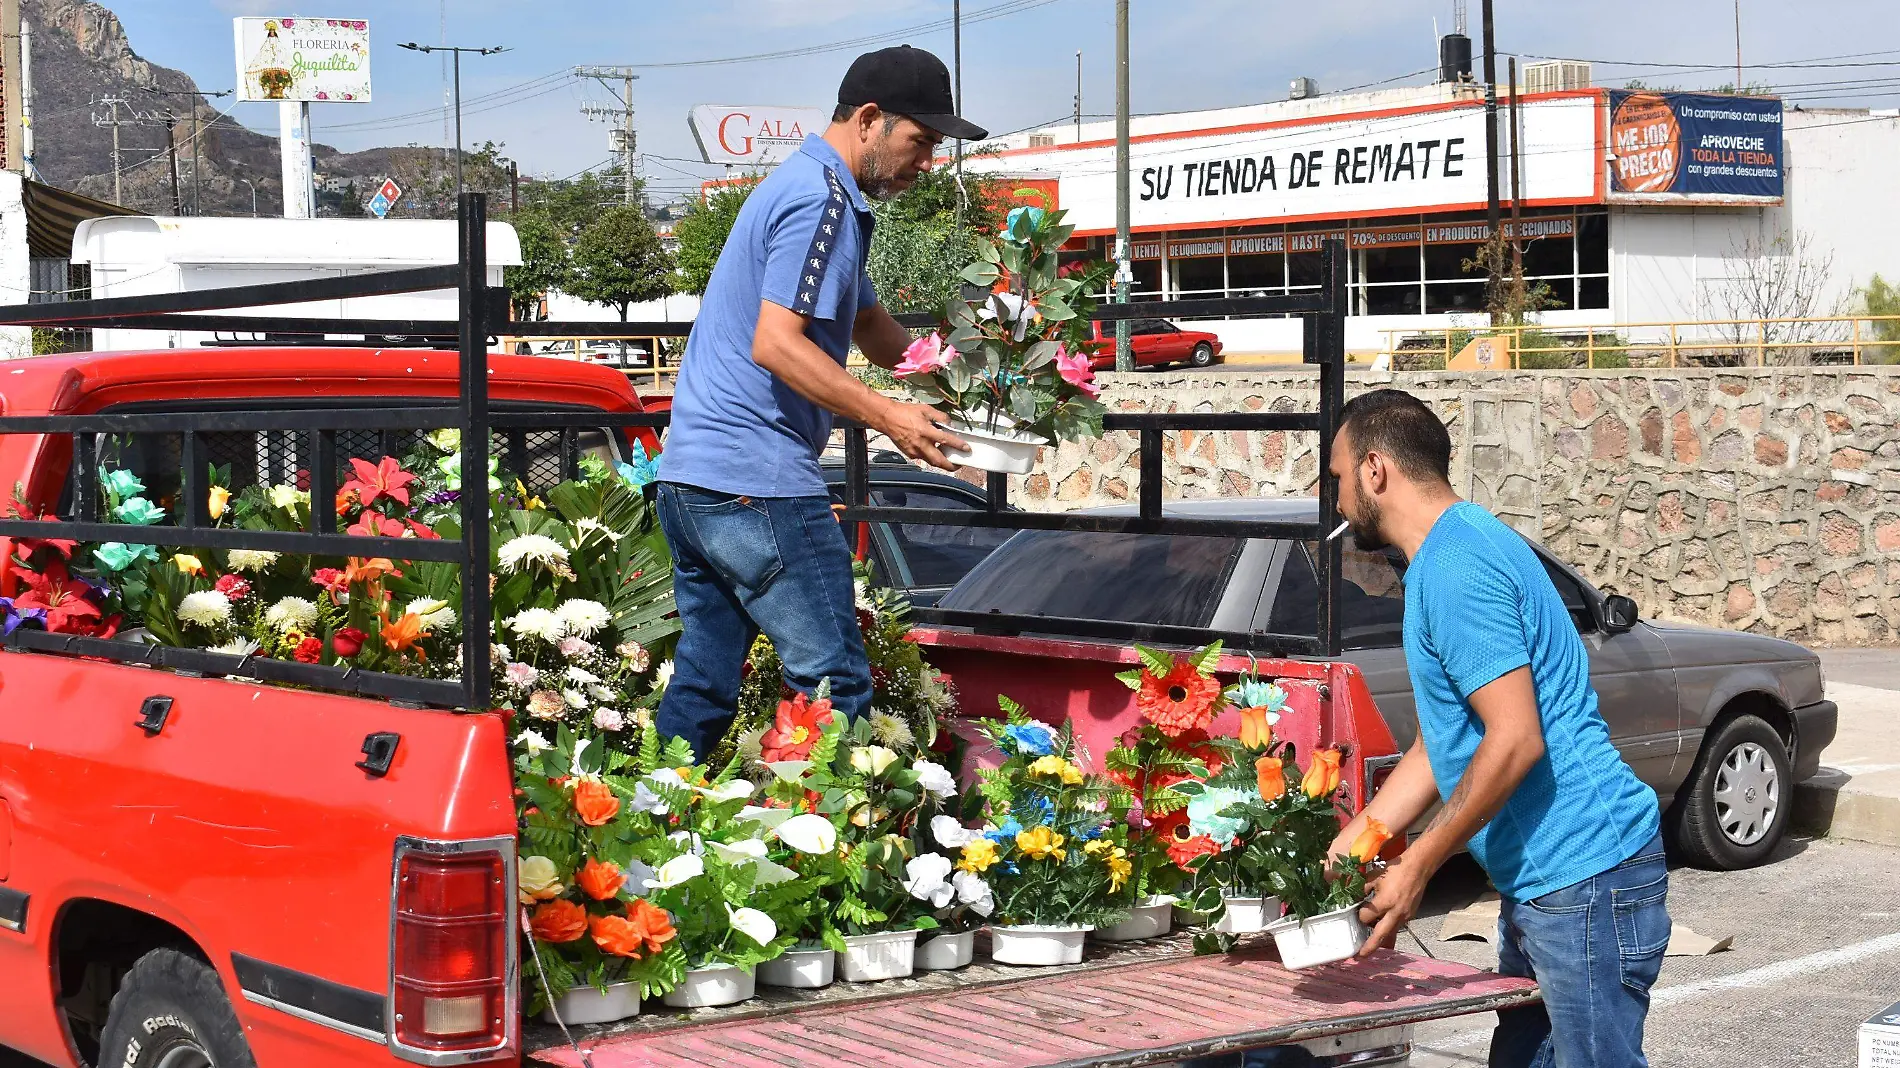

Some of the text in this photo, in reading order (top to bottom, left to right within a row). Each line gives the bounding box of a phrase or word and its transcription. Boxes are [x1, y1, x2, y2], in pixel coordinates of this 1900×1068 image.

[293, 39, 350, 50] FLORERIA
[1681, 106, 1780, 123] Un compromiso con usted
[718, 112, 804, 156] GALA
[1616, 123, 1669, 152] MEJOR
[1700, 135, 1764, 150] APROVECHE
[1620, 148, 1672, 180] PRECIO
[1692, 148, 1775, 165] TODA LA TIENDA
[1140, 137, 1464, 201] SU TIENDA DE REMATE
[1688, 165, 1777, 178] con grandes descuentos
[1426, 225, 1489, 242] EN PRODUCTO
[1503, 219, 1572, 237] SEECCIONADOS
[1230, 237, 1284, 254] APROVECHE
[1292, 234, 1326, 250] HASTA
[1352, 233, 1377, 245] 70%
[1378, 233, 1387, 242] DE
[1387, 231, 1421, 241] DESCUENTO
[1134, 244, 1160, 259] VENTA
[1169, 240, 1224, 257] DE LIQUIDACIÓN
[1871, 1056, 1884, 1064] NET
[1872, 1047, 1892, 1056] TOTAL
